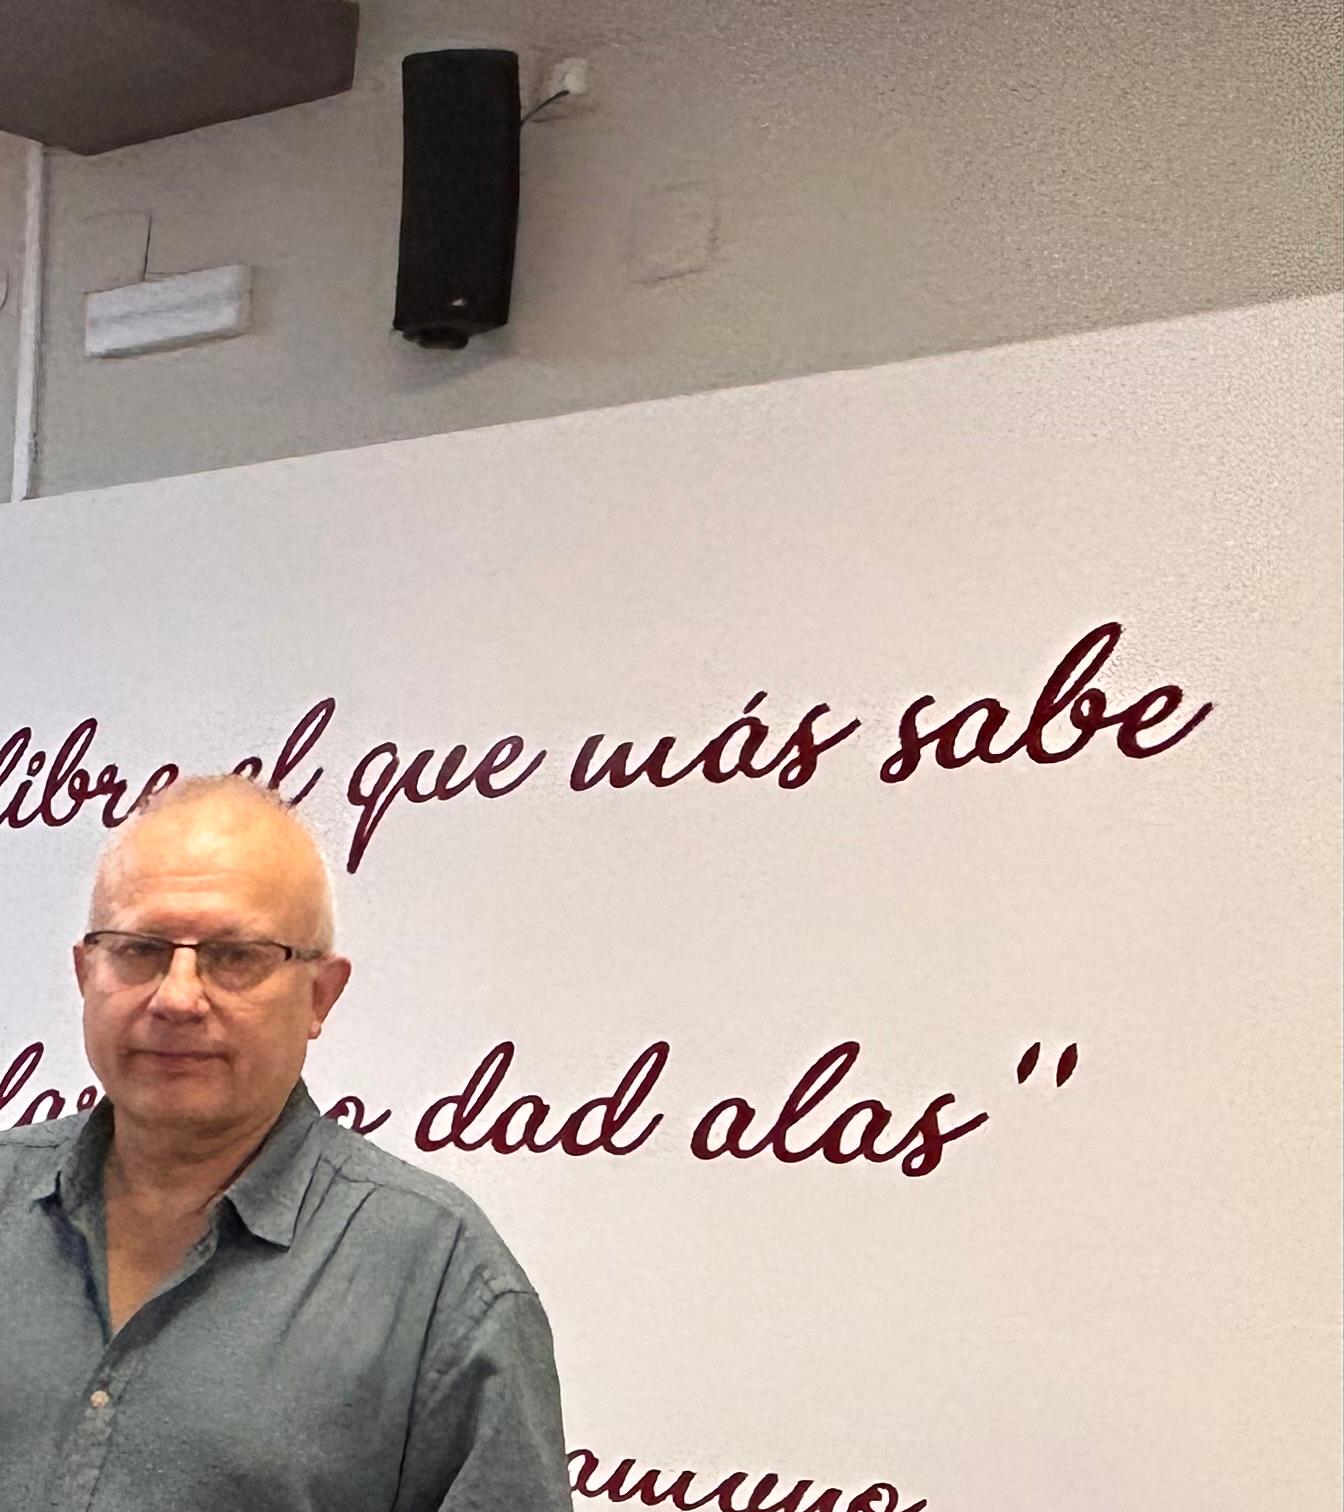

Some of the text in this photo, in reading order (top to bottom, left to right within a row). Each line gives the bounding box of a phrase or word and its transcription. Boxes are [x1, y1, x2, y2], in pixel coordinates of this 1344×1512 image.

[347, 735, 547, 875] que
[570, 691, 862, 792] más
[880, 622, 1214, 783] sabe
[415, 1041, 664, 1157] dad
